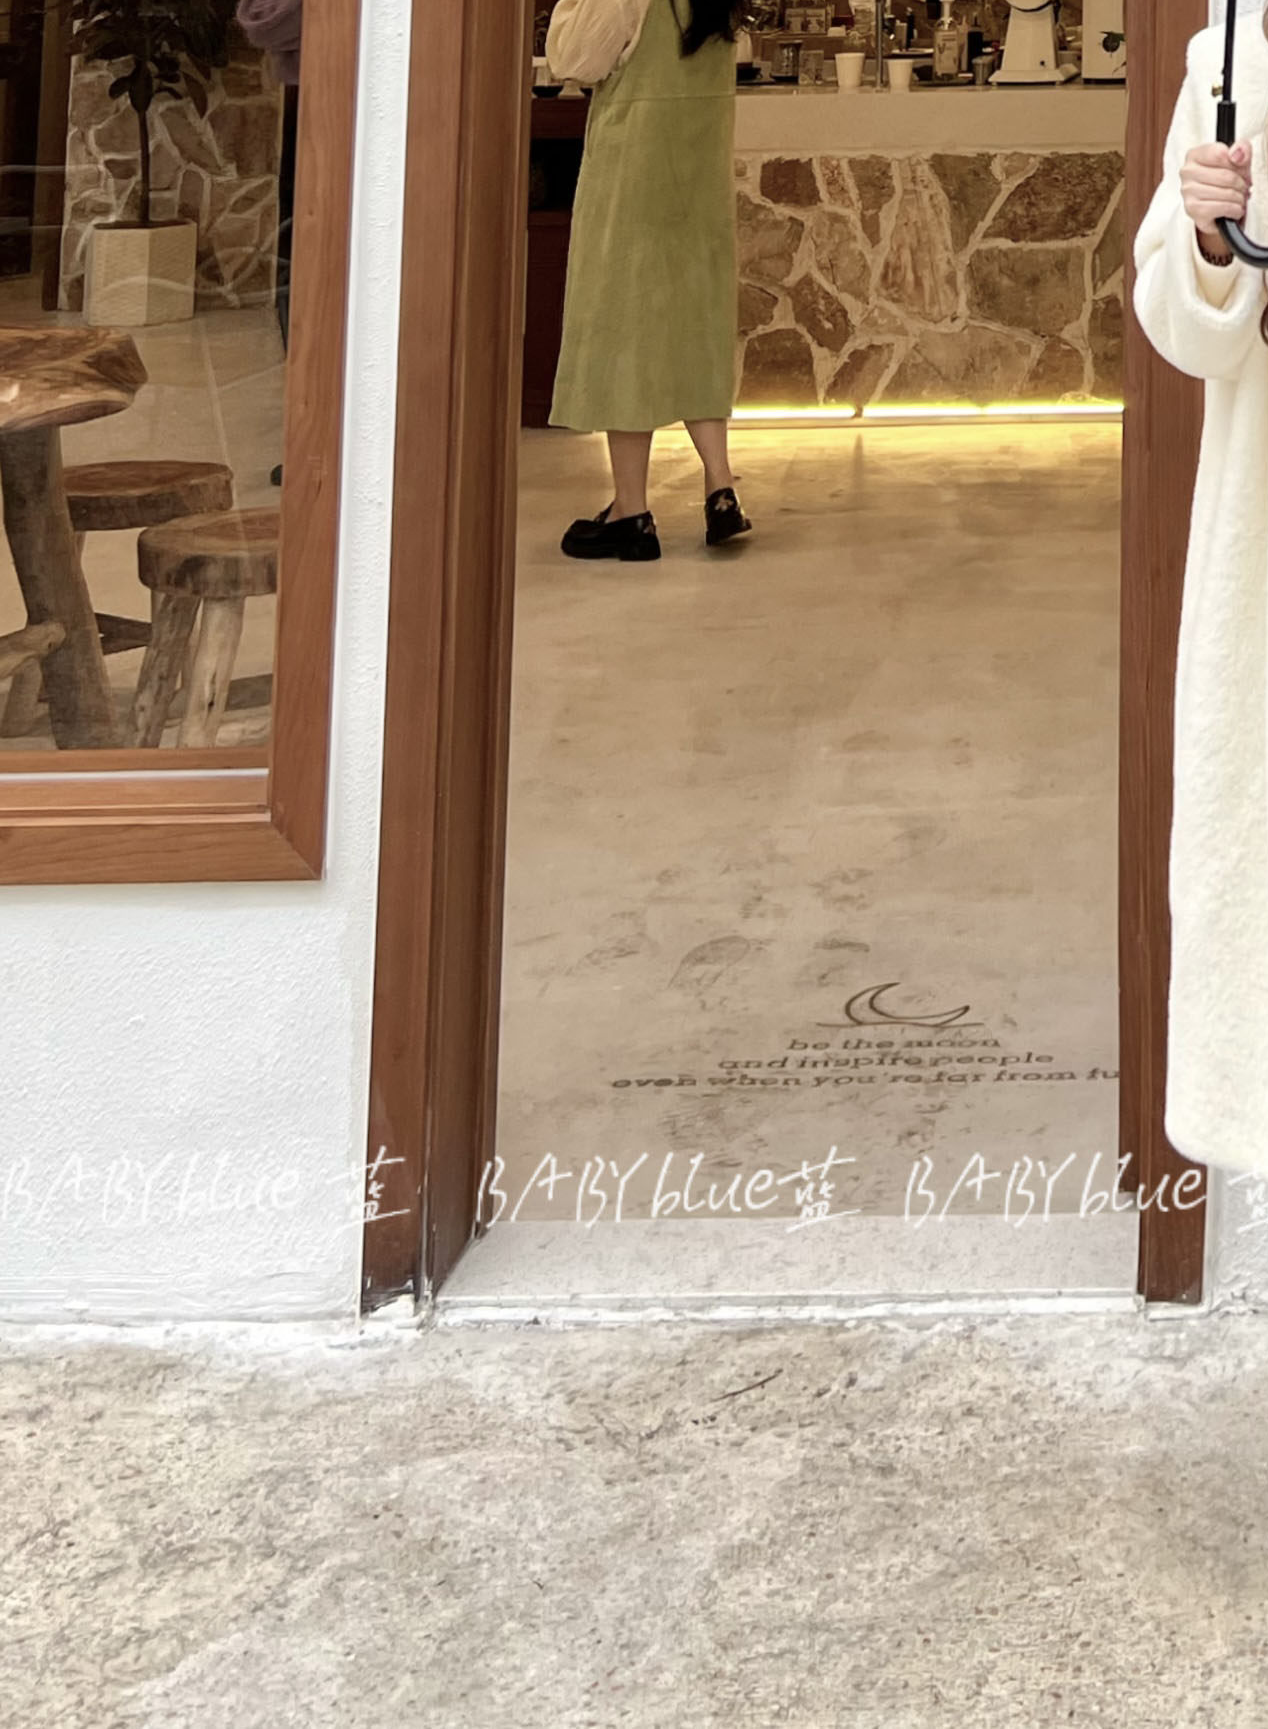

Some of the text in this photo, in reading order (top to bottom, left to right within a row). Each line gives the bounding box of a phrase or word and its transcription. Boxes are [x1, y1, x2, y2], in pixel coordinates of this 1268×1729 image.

[787, 1038, 1001, 1051] be the moon
[717, 1050, 1054, 1070] and inspire people
[611, 1076, 697, 1088] even
[707, 1074, 801, 1087] when
[930, 1070, 987, 1084] far
[992, 1069, 1077, 1083] from
